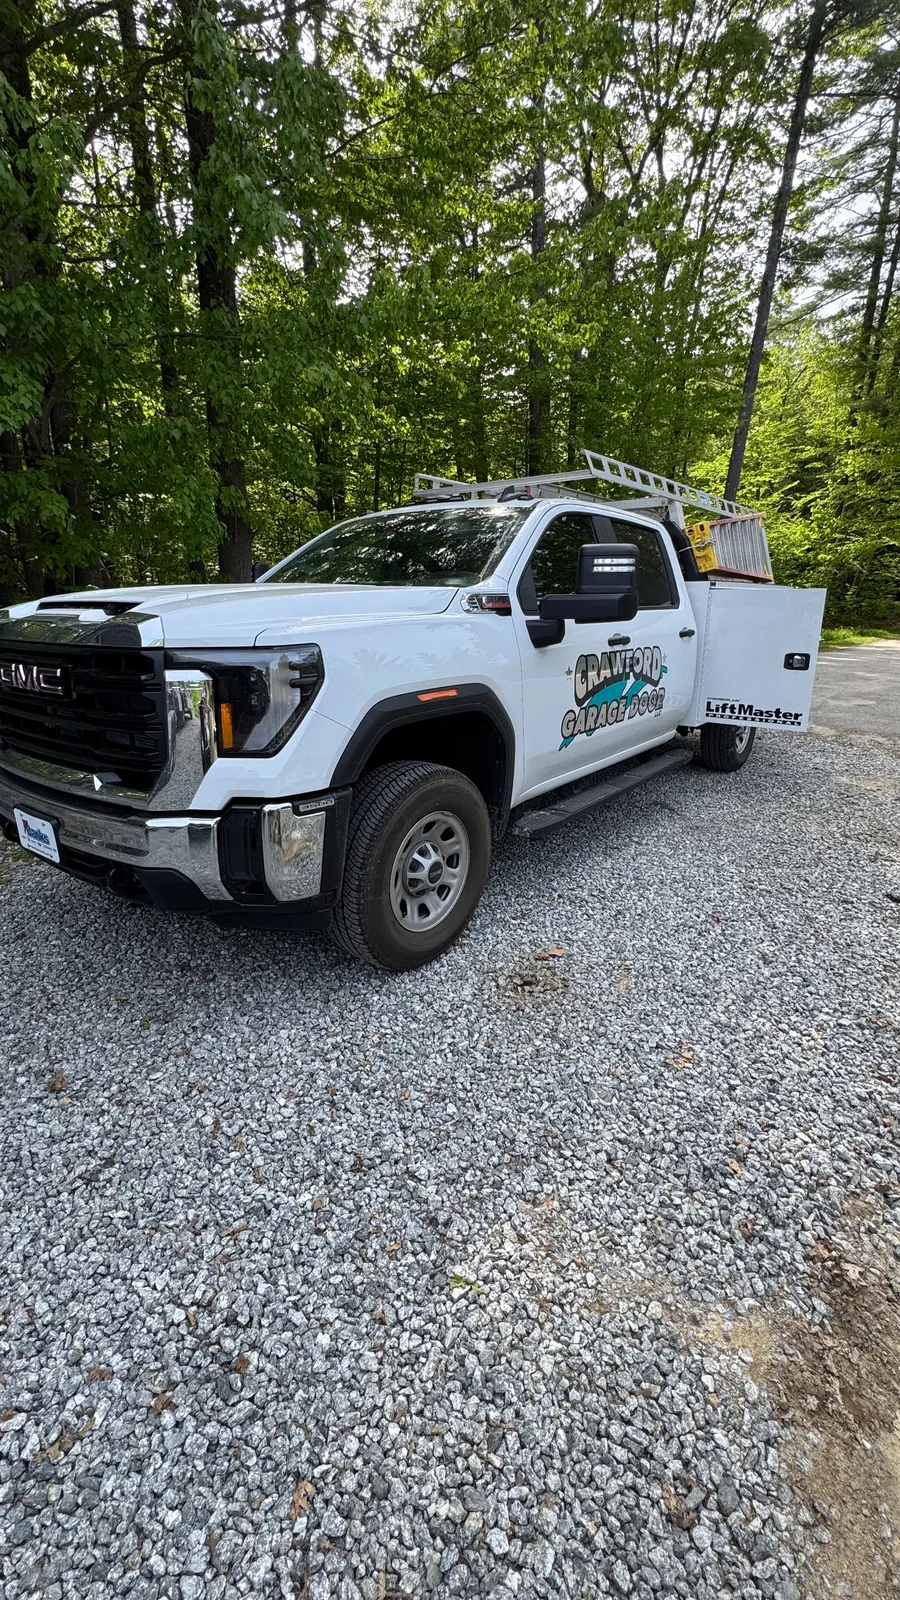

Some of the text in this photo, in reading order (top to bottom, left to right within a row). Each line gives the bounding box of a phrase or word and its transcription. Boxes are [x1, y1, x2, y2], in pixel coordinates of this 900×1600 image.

[0, 662, 63, 695] GMC
[574, 646, 662, 706] CRAWFORD
[561, 687, 666, 739] GARAGE DOOR
[705, 701, 802, 721] LiftMaster
[707, 713, 801, 726] PROFESSIONAL
